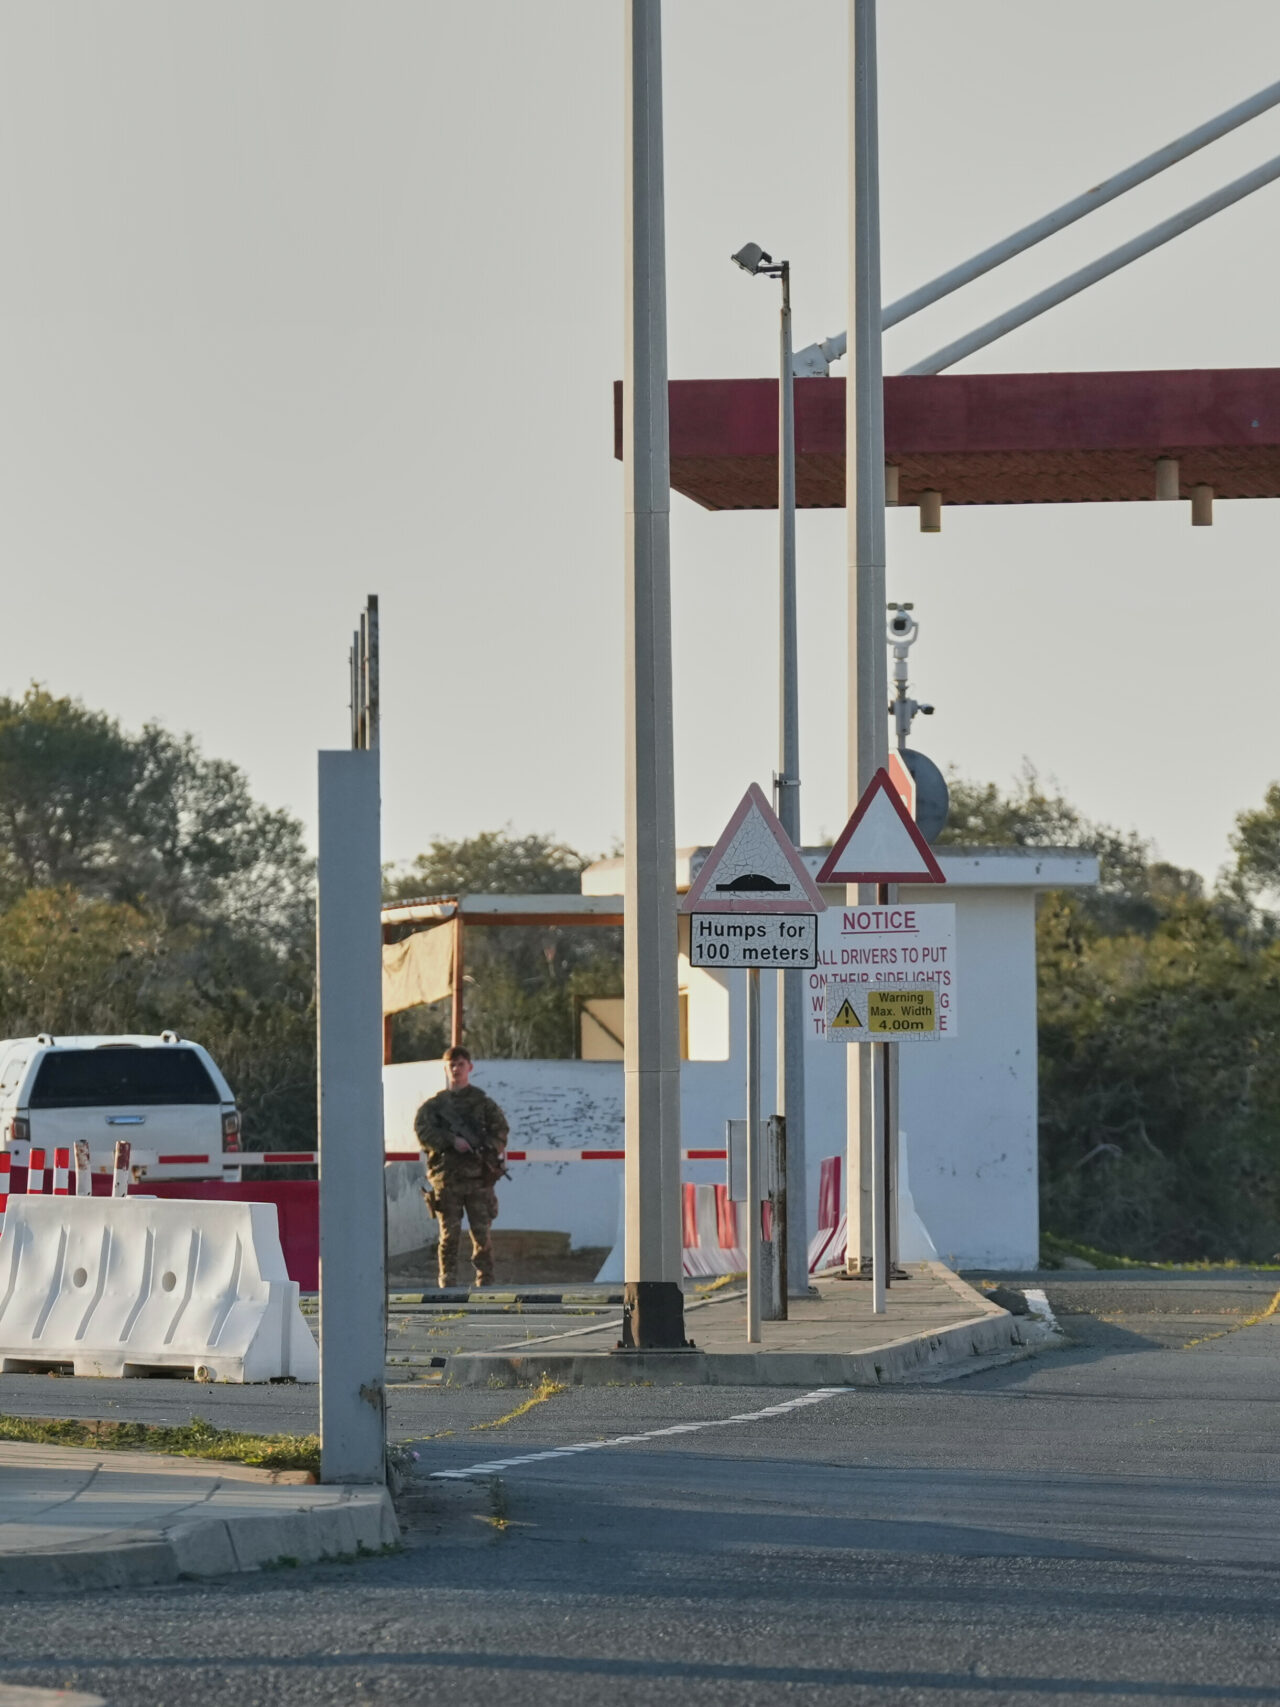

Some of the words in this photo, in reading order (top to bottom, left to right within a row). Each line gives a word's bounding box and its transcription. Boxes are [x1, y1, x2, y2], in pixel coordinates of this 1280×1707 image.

[843, 911, 916, 930] NOTICE
[700, 921, 767, 940] Humps
[779, 922, 805, 938] for
[696, 944, 729, 959] 100
[743, 945, 809, 960] meters
[841, 948, 898, 965] DRIVERS
[901, 947, 919, 963] TO
[922, 947, 947, 963] PUT
[879, 992, 924, 1004] Warning
[870, 1006, 896, 1016] Max.
[901, 1006, 932, 1016] Width
[879, 1020, 924, 1030] 4.00m
